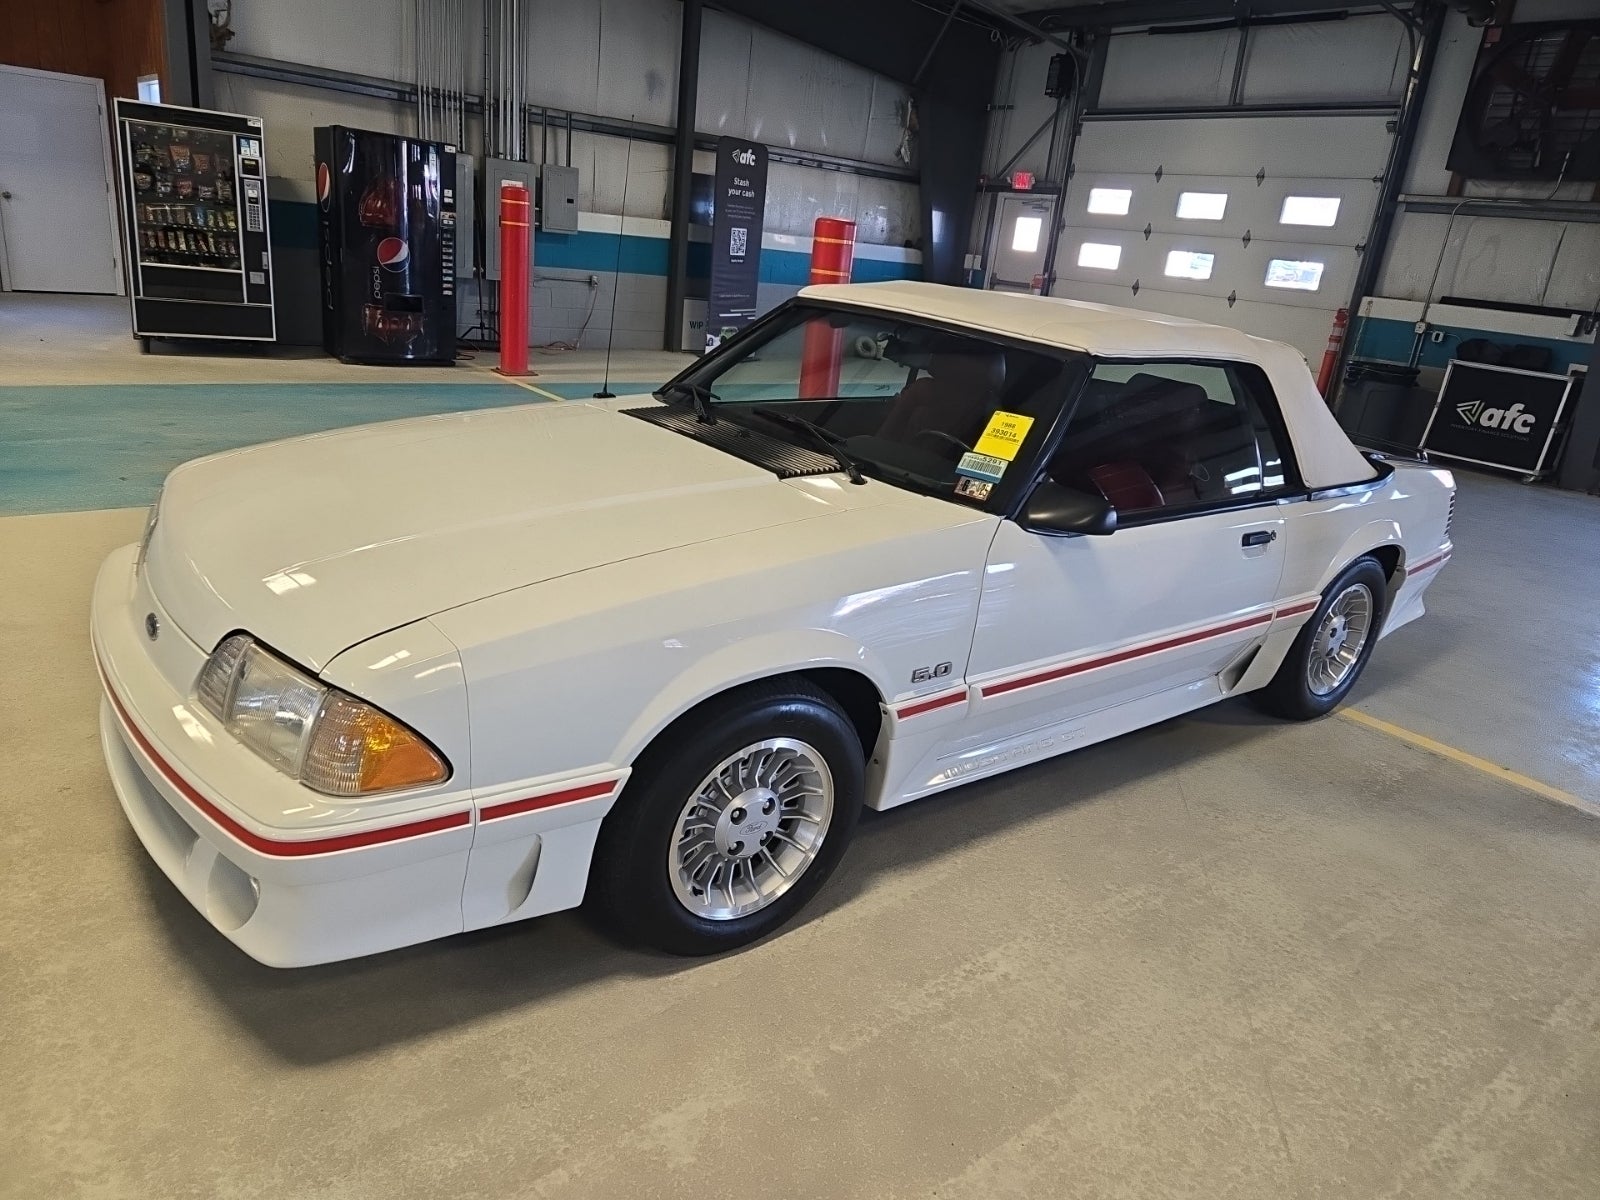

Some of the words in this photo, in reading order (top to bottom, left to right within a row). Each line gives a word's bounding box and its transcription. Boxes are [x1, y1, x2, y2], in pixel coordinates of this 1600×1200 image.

[740, 149, 756, 166] afc
[733, 177, 750, 187] Stash
[728, 187, 741, 197] your
[742, 189, 755, 198] cash
[372, 266, 382, 299] pepsi
[1479, 402, 1536, 434] afc
[991, 428, 1017, 438] 393014
[911, 662, 952, 683] 5.0
